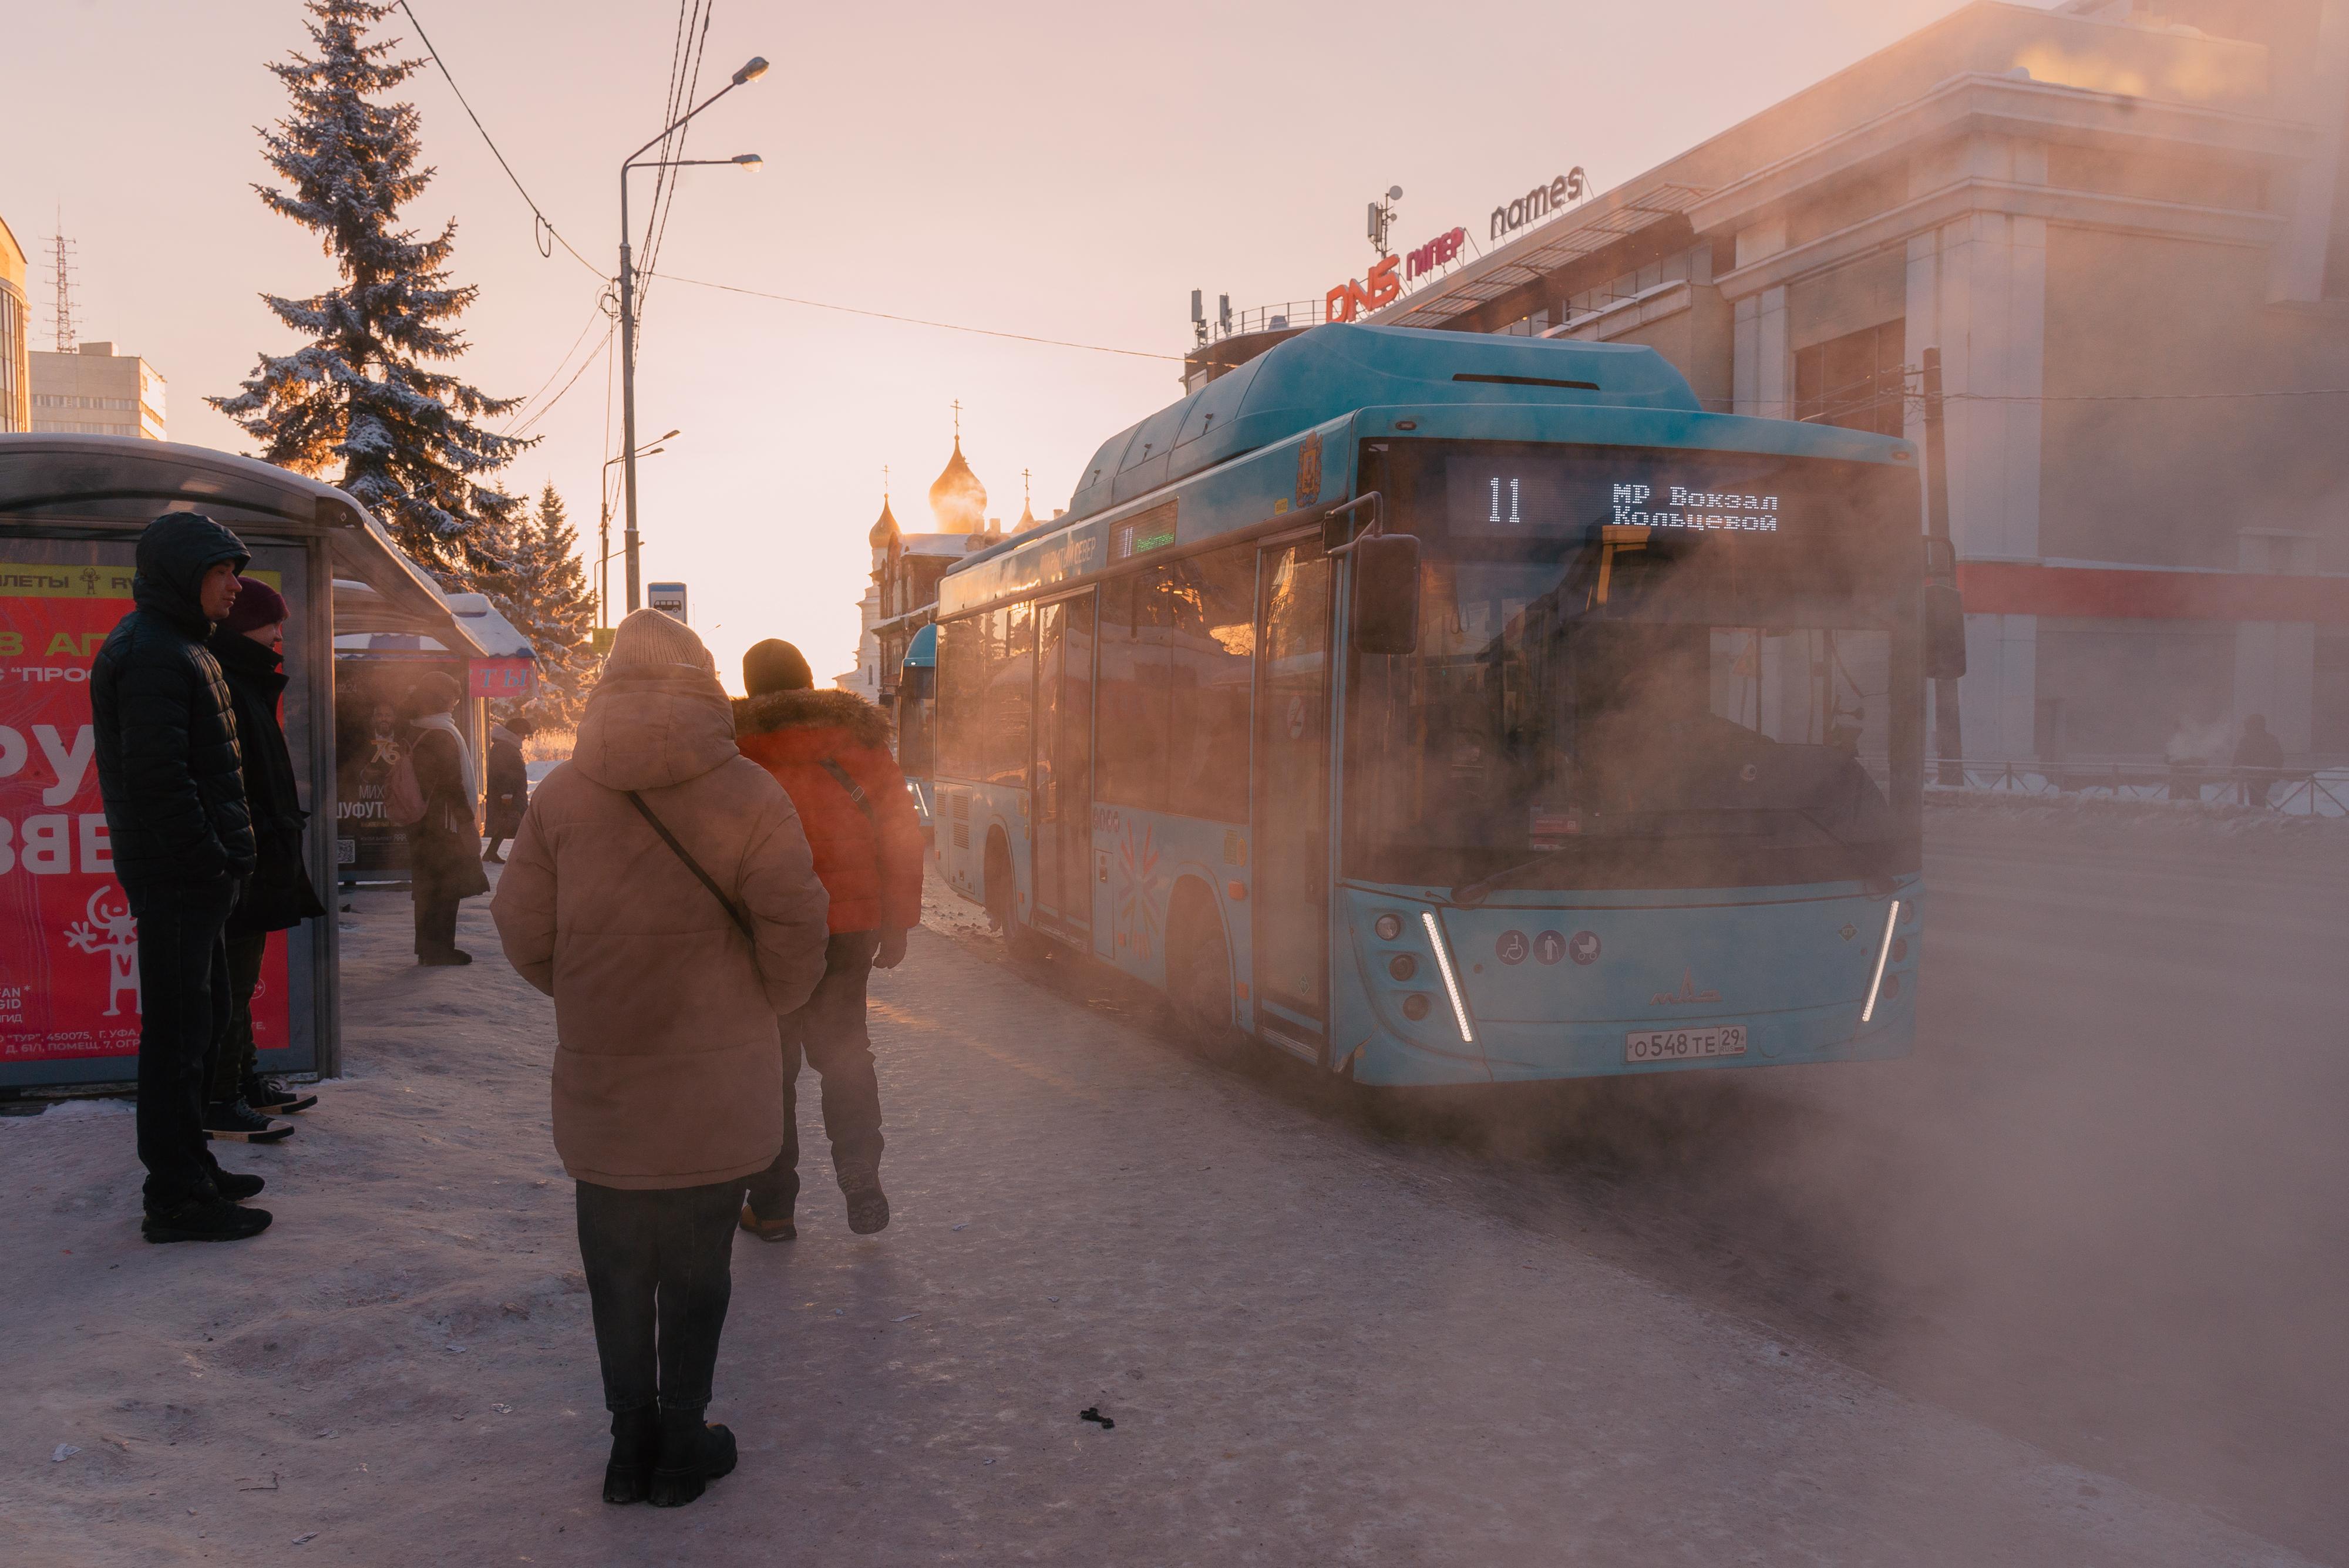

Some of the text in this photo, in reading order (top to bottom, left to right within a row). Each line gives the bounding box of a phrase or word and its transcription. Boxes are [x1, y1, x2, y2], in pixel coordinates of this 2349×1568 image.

[1490, 166, 1584, 241] names
[1326, 227, 1465, 324] DNS ГИПЕР
[1489, 477, 1520, 523] 11
[1670, 486, 1778, 510] Вокзал
[1613, 505, 1777, 531] Кольцевой
[1074, 537, 1096, 564] СЕВЕР
[0, 574, 69, 588] ЛЕТЫ
[0, 1014, 23, 1024] ГИД
[1721, 1029, 1739, 1047] 29
